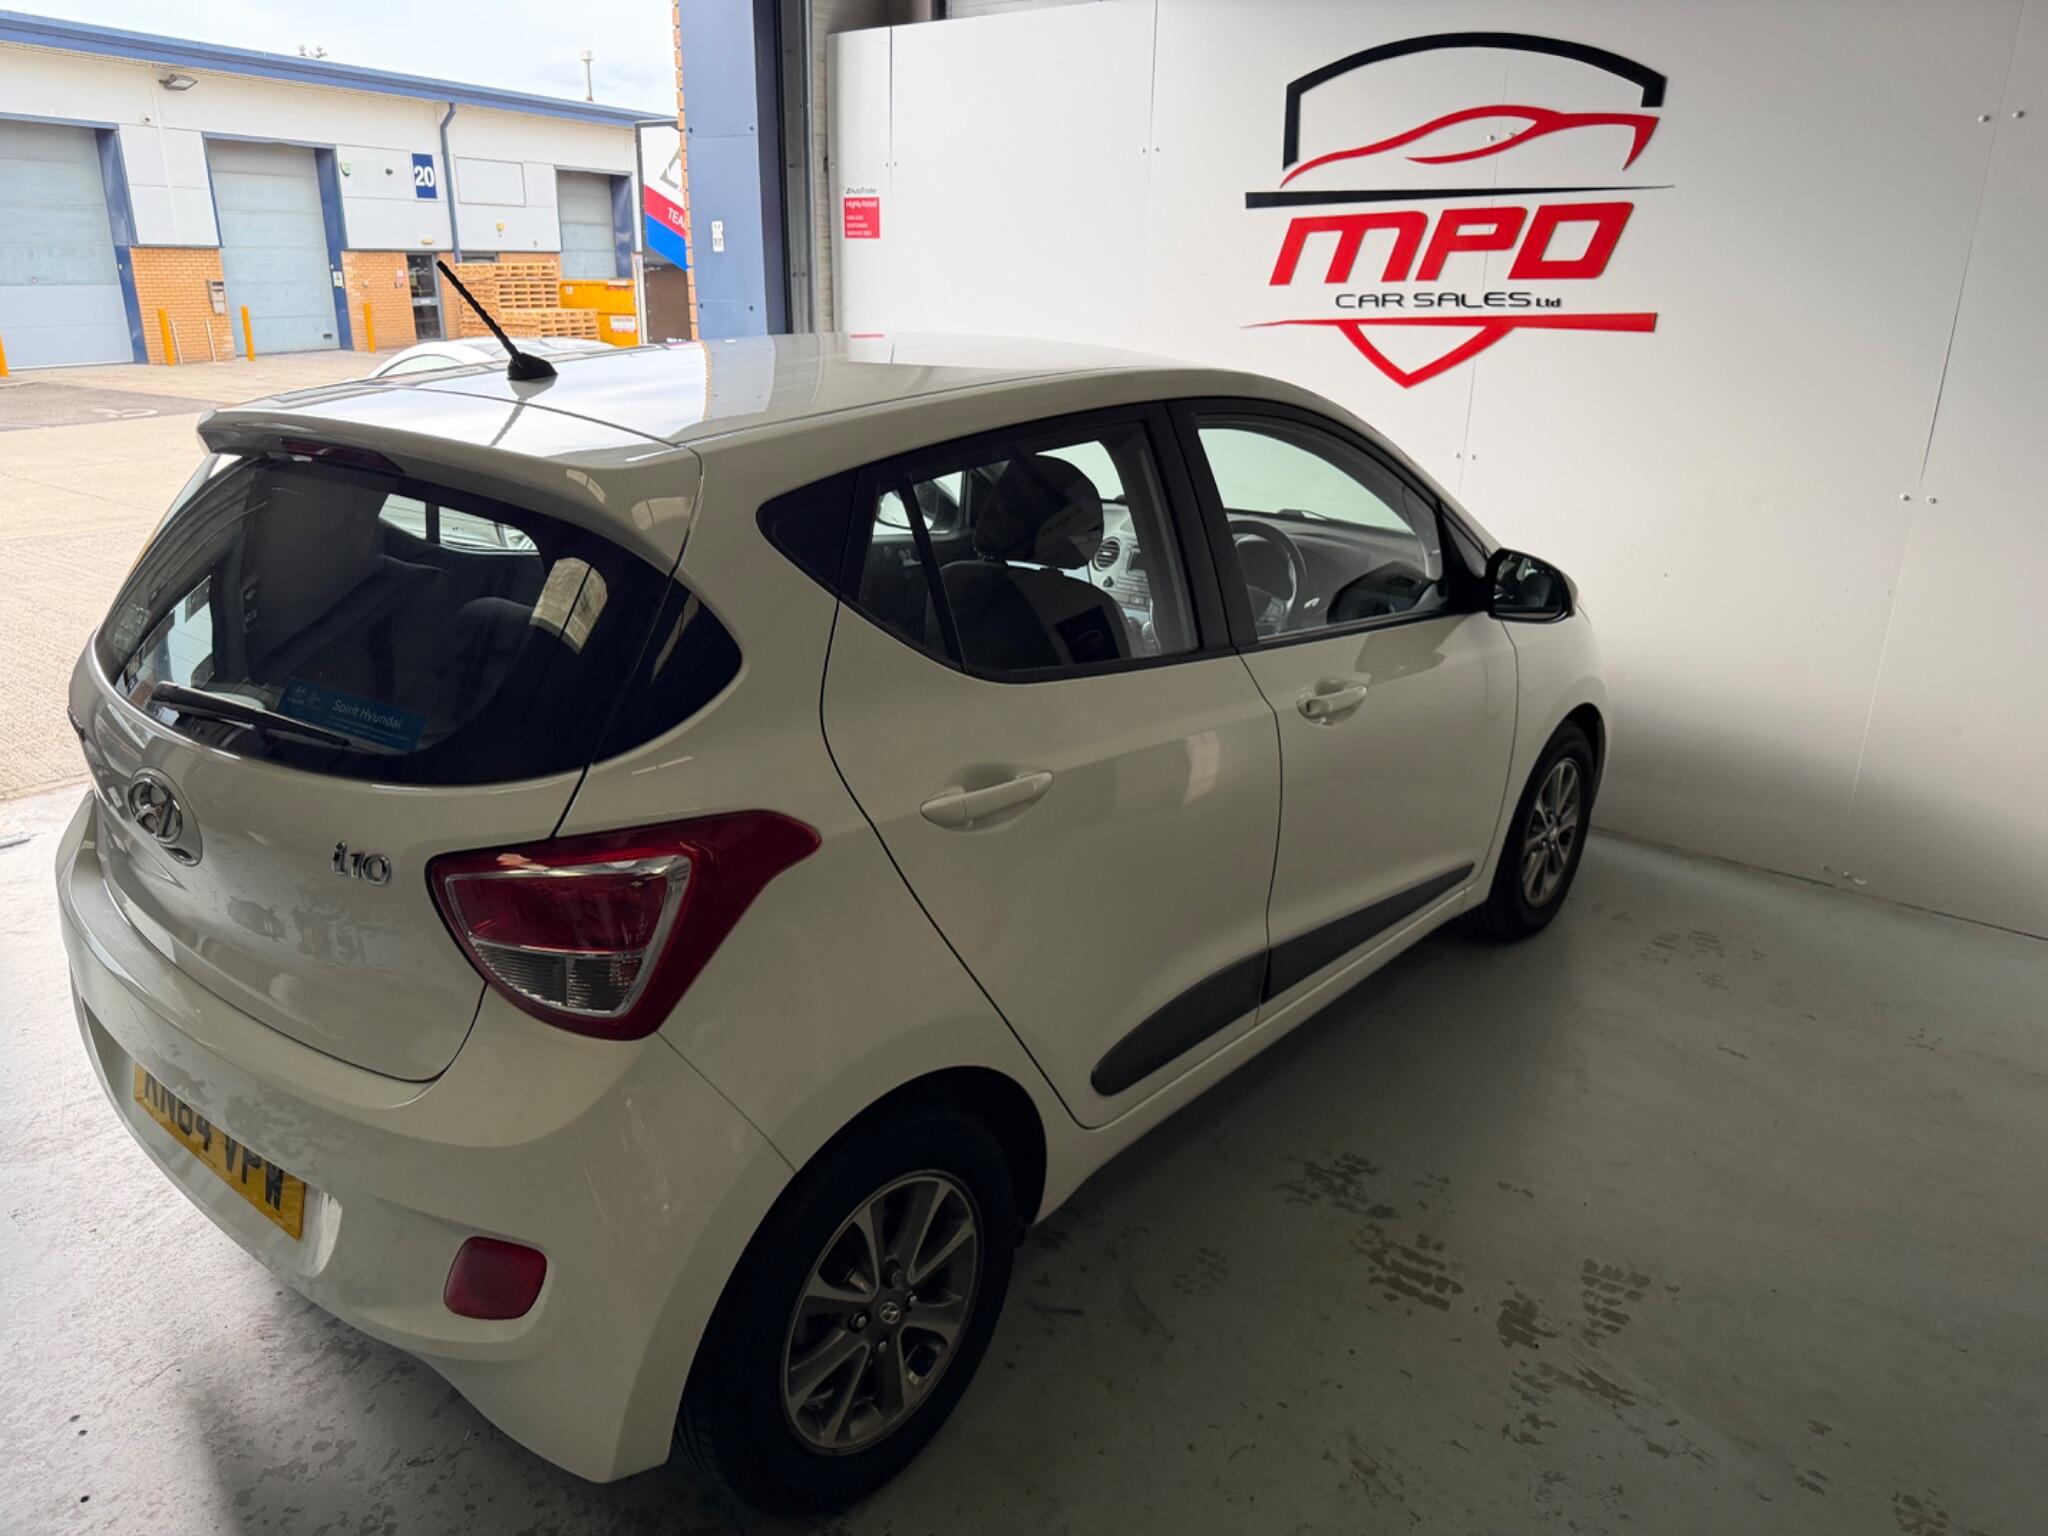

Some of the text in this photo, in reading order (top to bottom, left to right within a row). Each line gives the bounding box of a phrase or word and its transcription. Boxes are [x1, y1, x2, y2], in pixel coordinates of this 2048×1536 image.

[414, 165, 435, 188] 20
[1335, 291, 1562, 309] CAR SALES Ltd
[332, 699, 405, 730] Spirit Hyundai
[331, 841, 392, 887] i10
